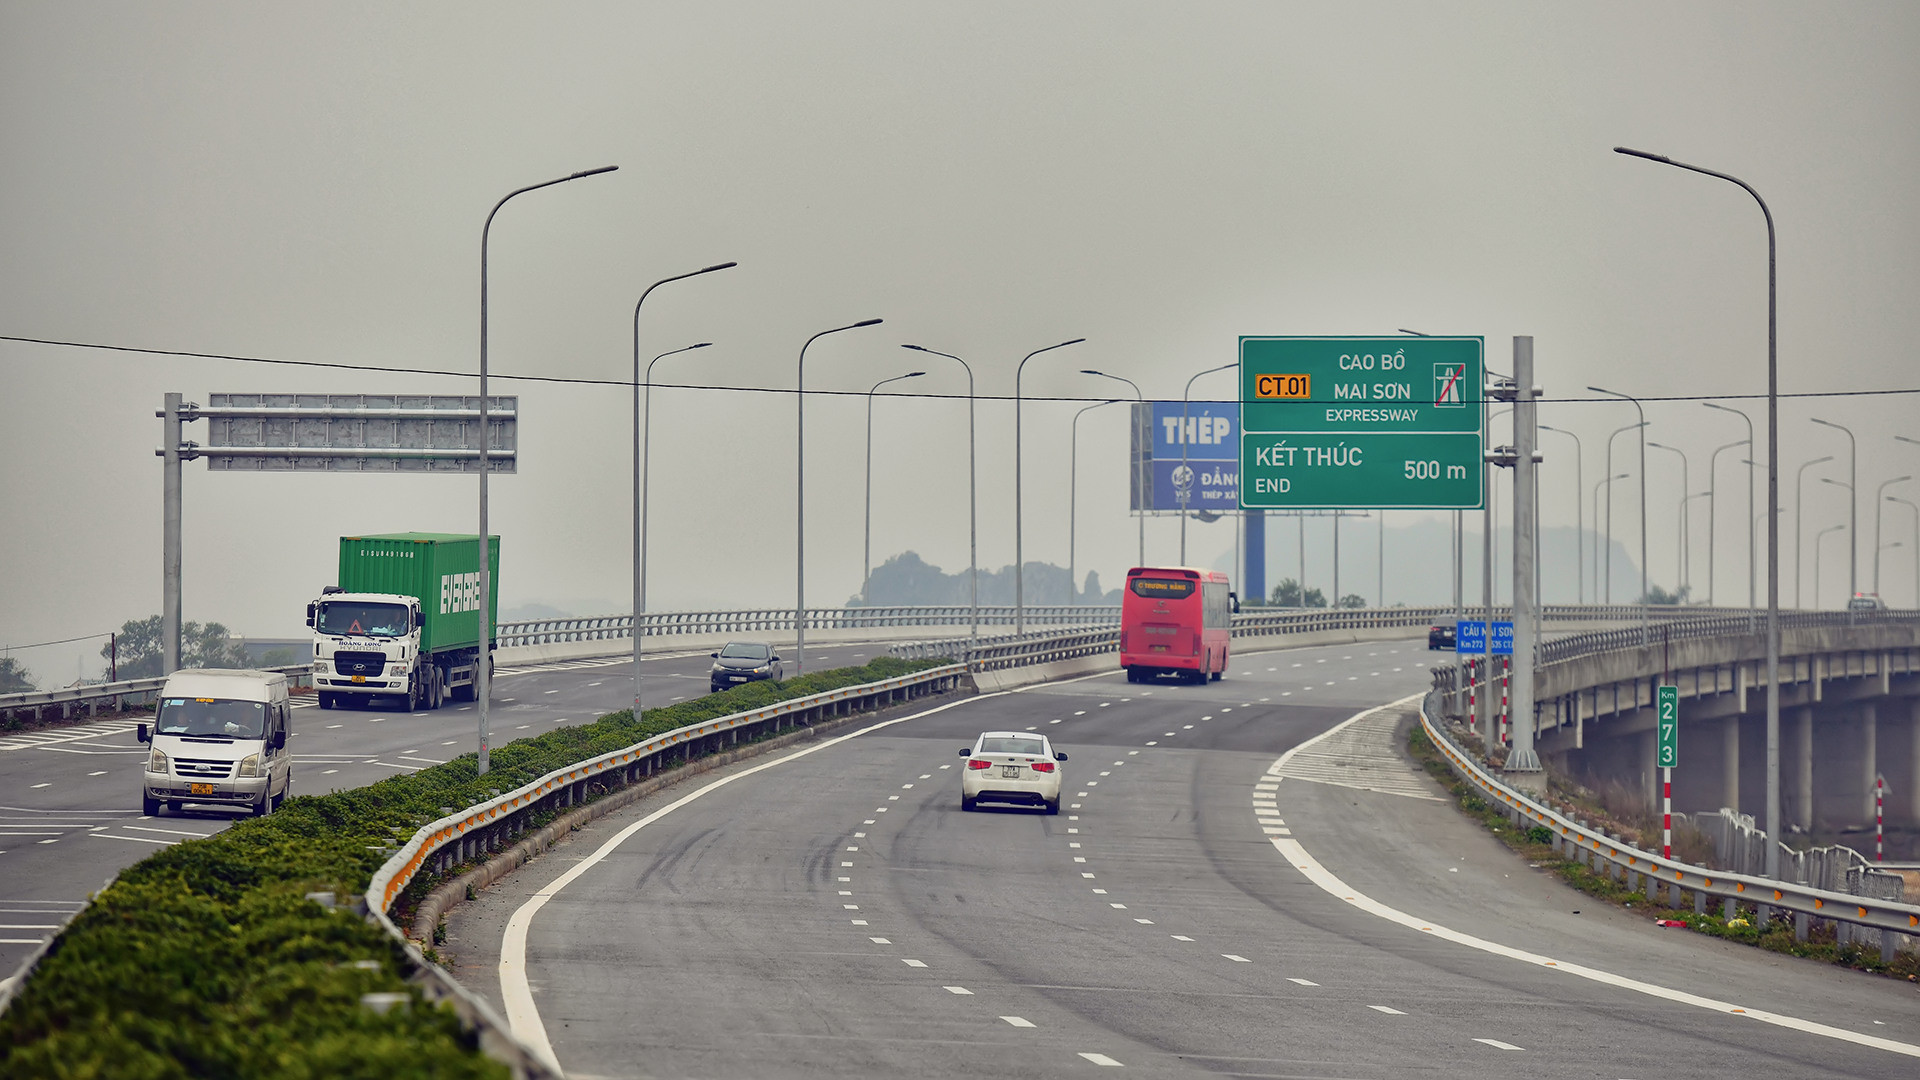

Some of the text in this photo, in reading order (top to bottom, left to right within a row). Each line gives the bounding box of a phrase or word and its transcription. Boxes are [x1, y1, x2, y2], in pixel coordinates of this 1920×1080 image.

[1339, 348, 1406, 370] CAO BỒ
[1258, 376, 1308, 396] CT.01
[1334, 382, 1411, 400] MAI SƠN
[1325, 409, 1419, 422] EXPRESSWAY
[1162, 410, 1231, 445] THÉP
[1256, 440, 1363, 467] KẾT THÚC
[1404, 460, 1466, 480] 500 m
[1255, 478, 1291, 494] END
